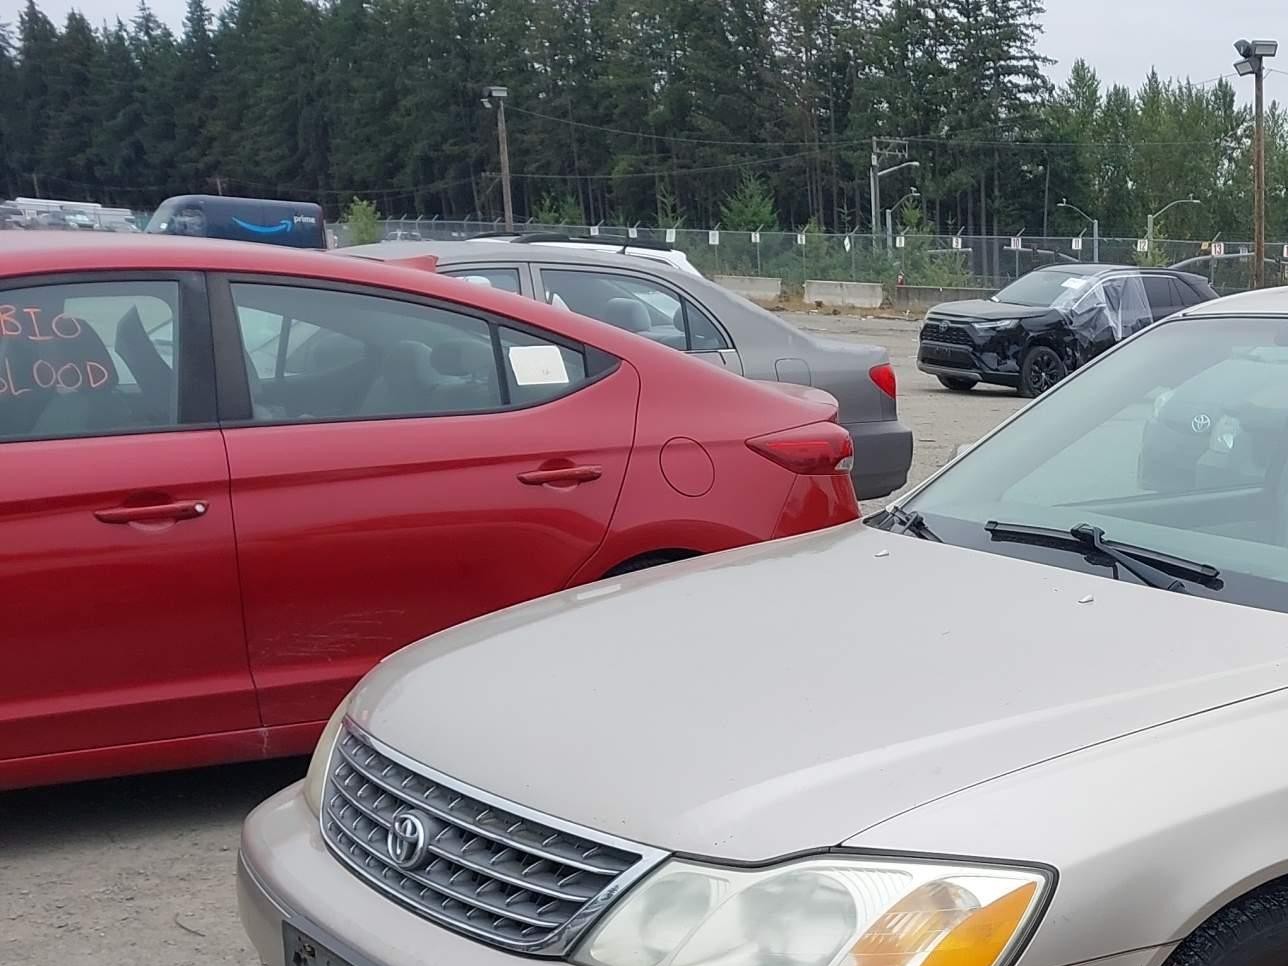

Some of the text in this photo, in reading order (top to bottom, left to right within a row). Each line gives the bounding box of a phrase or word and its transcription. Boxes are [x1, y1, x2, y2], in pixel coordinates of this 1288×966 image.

[293, 214, 316, 224] prime
[1213, 243, 1222, 255] 13
[0, 304, 82, 340] BIO
